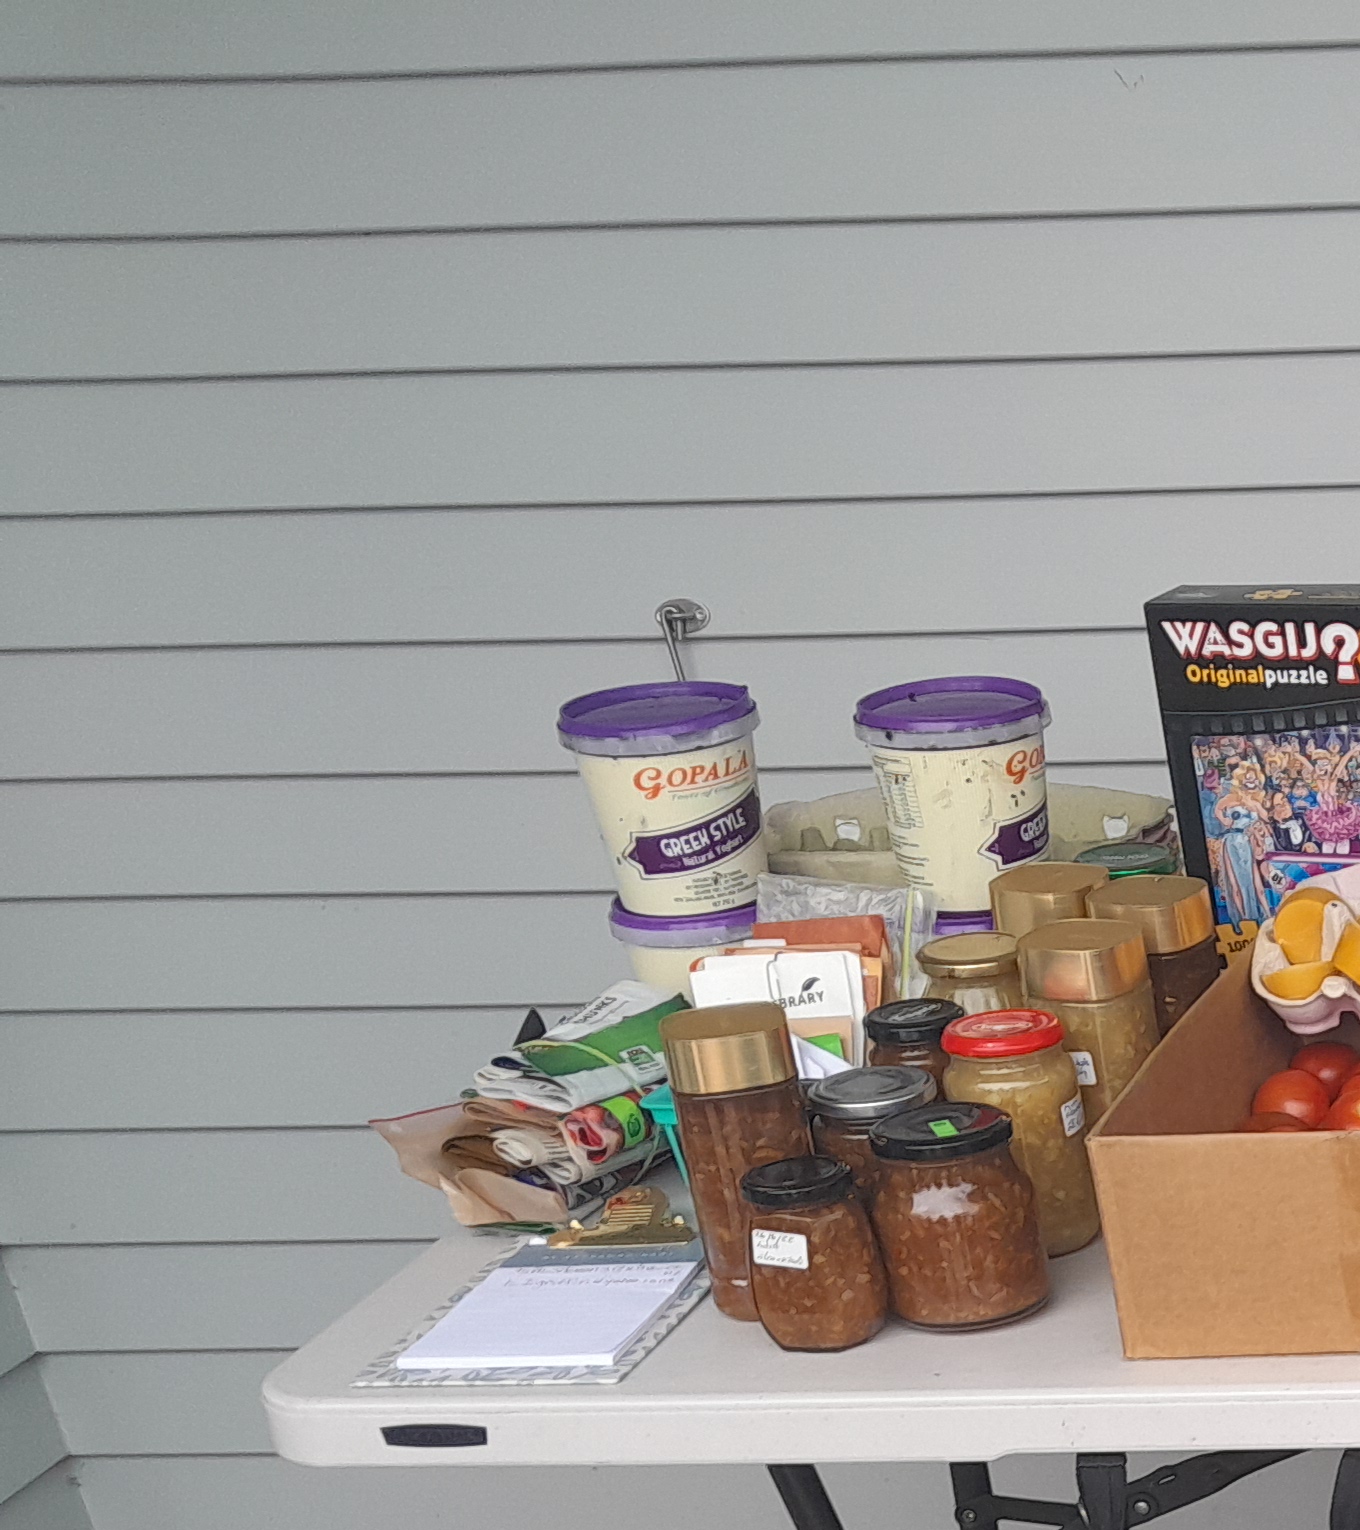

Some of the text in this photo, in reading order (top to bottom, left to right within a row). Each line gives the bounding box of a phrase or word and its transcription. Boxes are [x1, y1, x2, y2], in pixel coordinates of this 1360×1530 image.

[633, 749, 750, 800] GOPALA
[659, 807, 747, 858] GREEK STYLE
[778, 990, 825, 1008] BRARY
